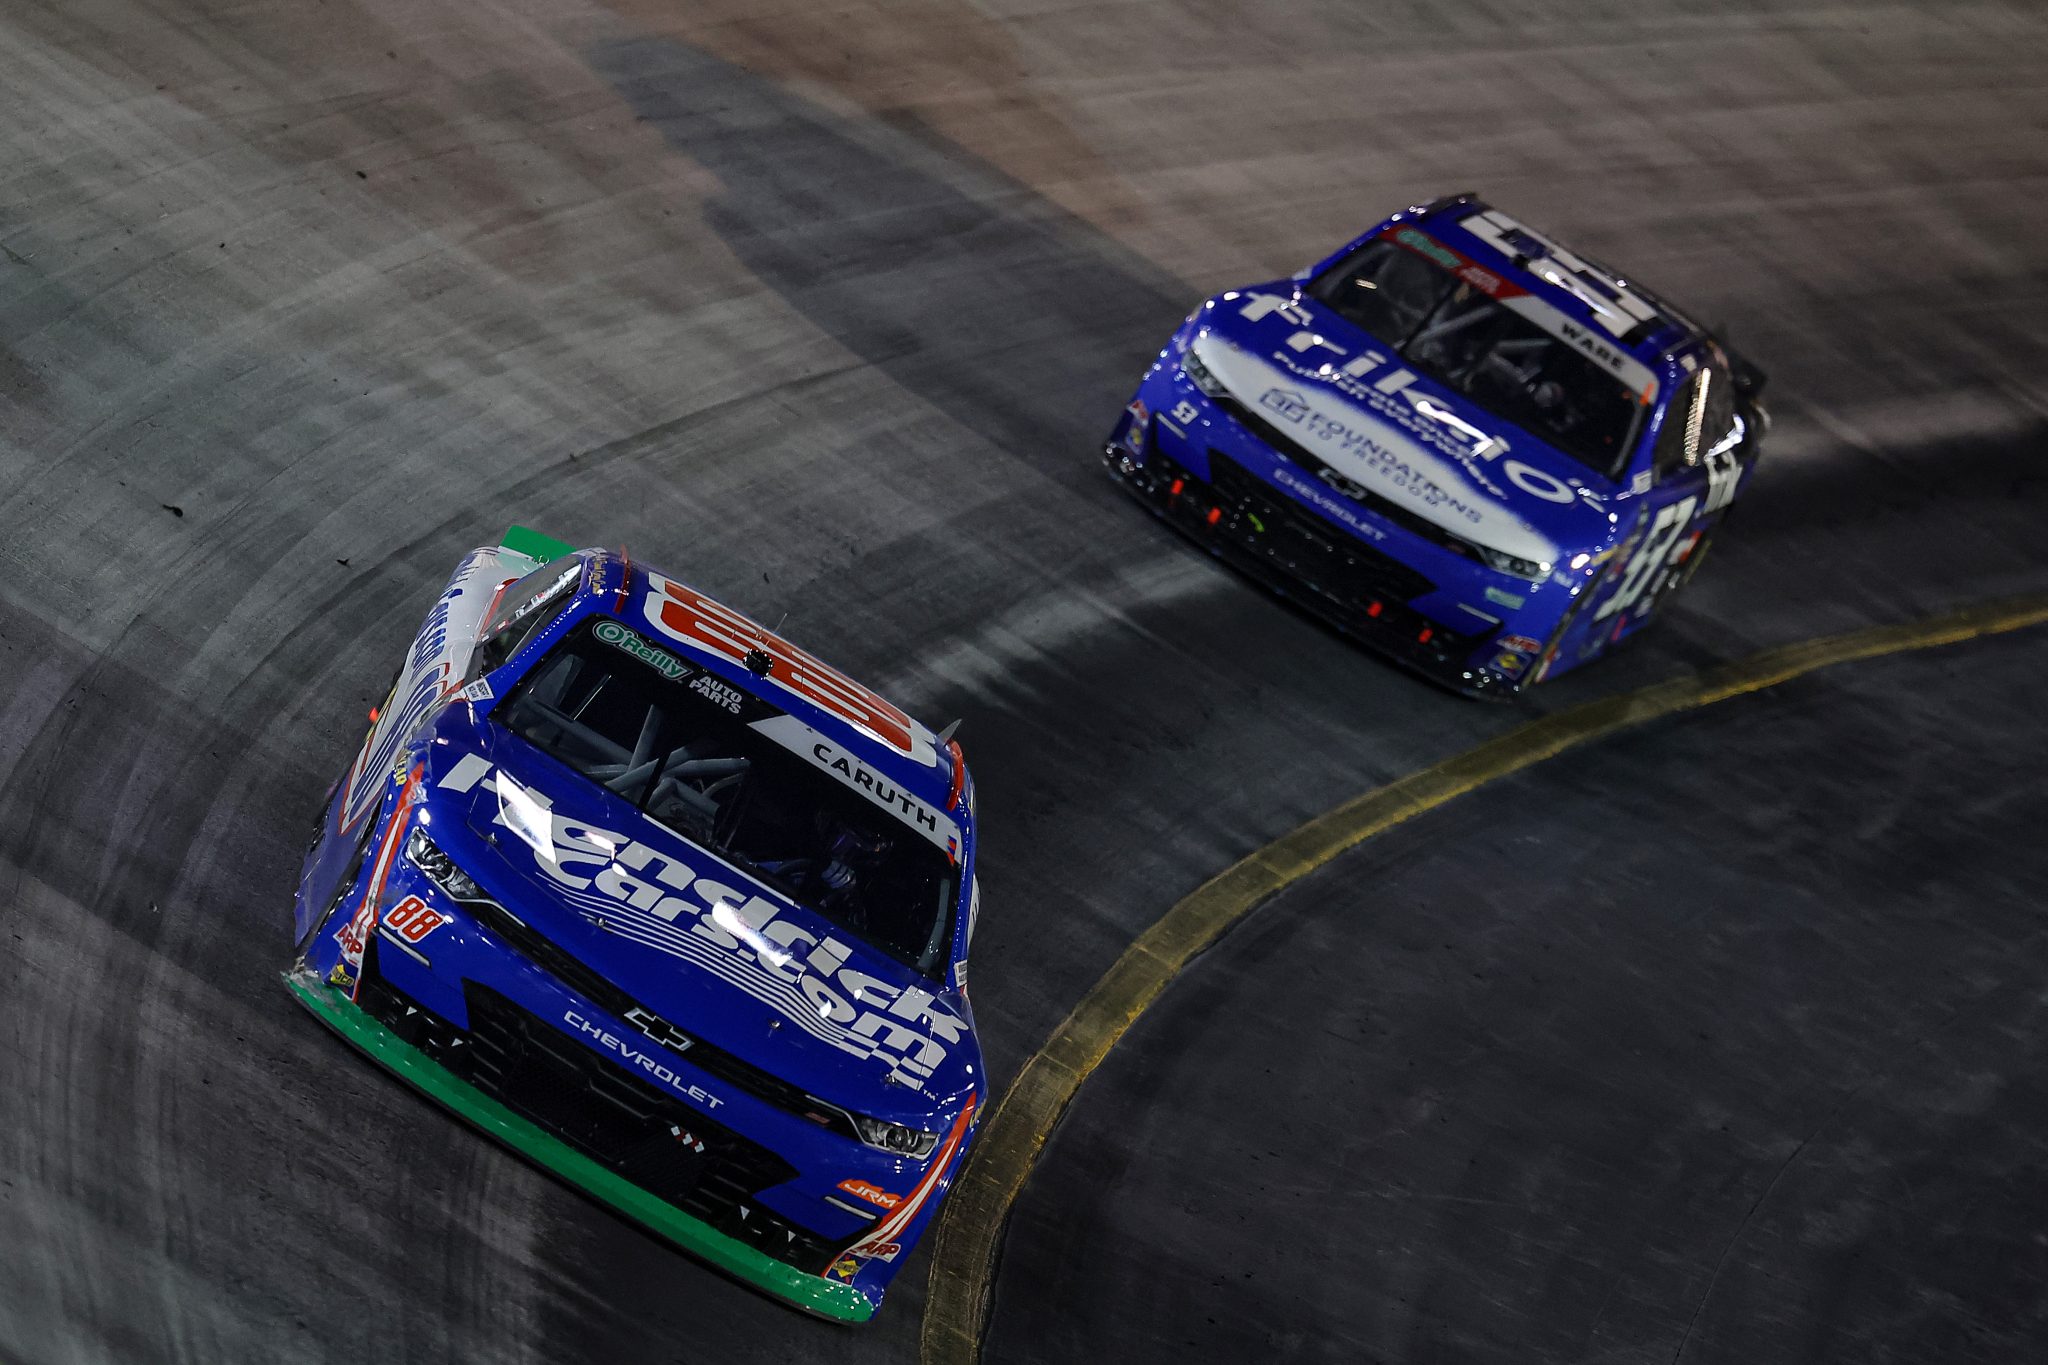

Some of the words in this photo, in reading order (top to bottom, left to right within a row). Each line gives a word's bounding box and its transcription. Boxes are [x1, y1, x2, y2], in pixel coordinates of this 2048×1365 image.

[1307, 410, 1483, 524] FOUNDATIONS
[1339, 440, 1441, 509] FREEDOM
[1273, 467, 1388, 542] CHEVROLET
[593, 621, 691, 680] O'Reilly
[688, 679, 742, 715] PARTS
[700, 674, 743, 704] AUTO
[812, 742, 938, 833] CARUTH
[383, 894, 444, 943] 88
[437, 752, 970, 1044] Hendrick
[533, 848, 948, 1078] Cars.com
[563, 1009, 725, 1110] CHEVROLET
[844, 1181, 900, 1208] JRM
